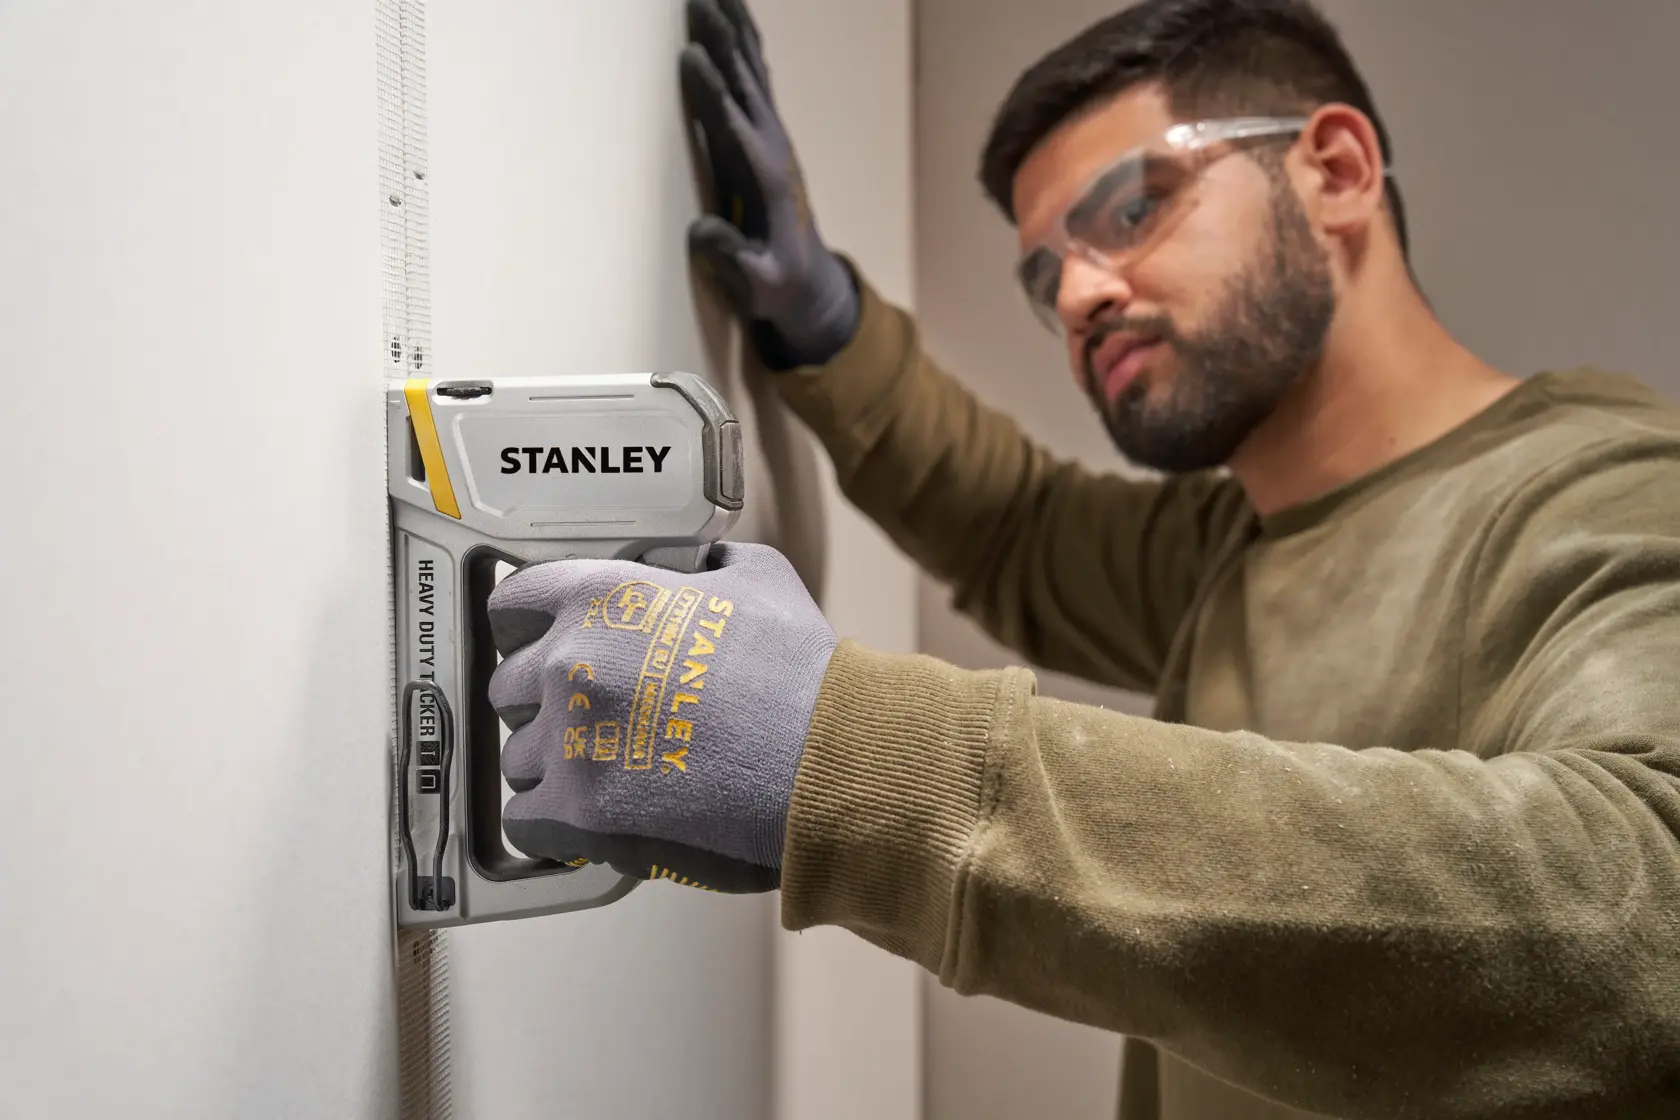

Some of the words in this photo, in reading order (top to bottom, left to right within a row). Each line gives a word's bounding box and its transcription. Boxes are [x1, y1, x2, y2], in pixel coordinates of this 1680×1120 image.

[500, 446, 672, 474] STANLEY
[418, 560, 435, 616] HEAVY
[419, 621, 435, 667] DUTY
[419, 671, 436, 736] TCKER
[662, 597, 735, 773] STANLEY
